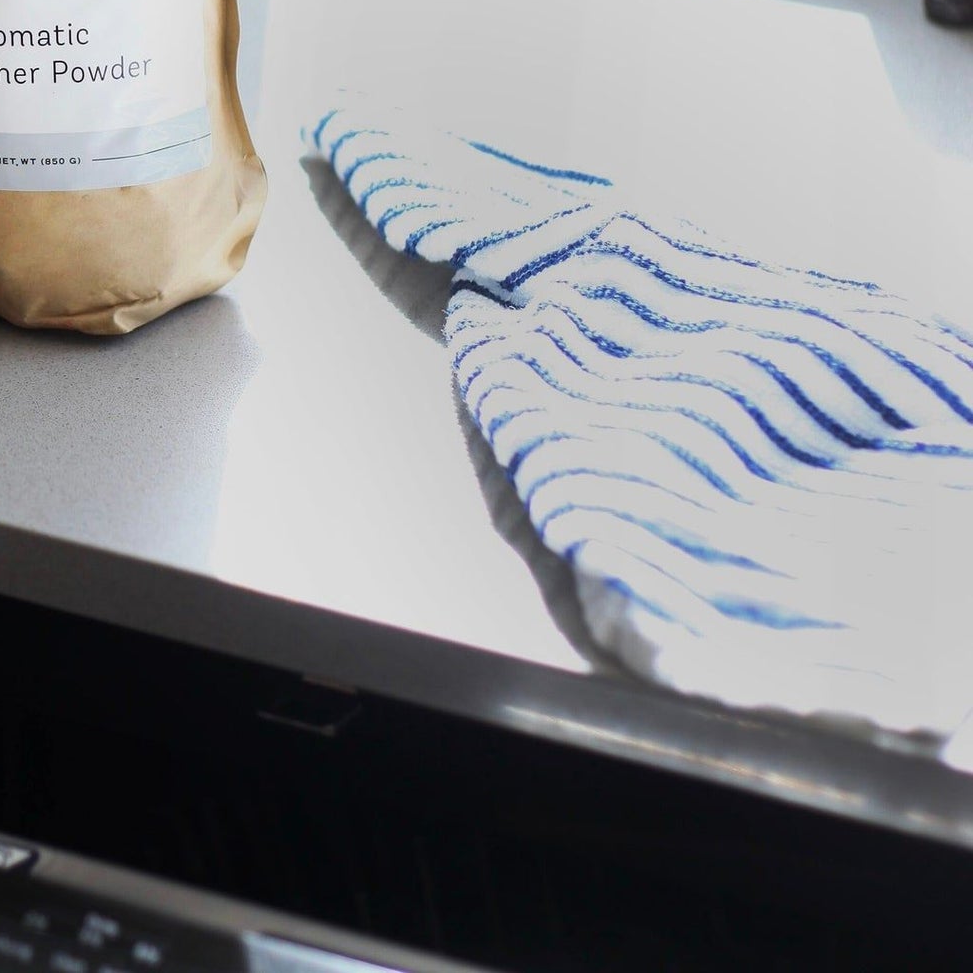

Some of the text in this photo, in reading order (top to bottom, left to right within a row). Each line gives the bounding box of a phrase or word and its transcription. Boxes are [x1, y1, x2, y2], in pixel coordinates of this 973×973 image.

[53, 56, 151, 83] Powder
[21, 157, 37, 166] WT
[40, 157, 66, 166] (850
[68, 156, 82, 165] G)
